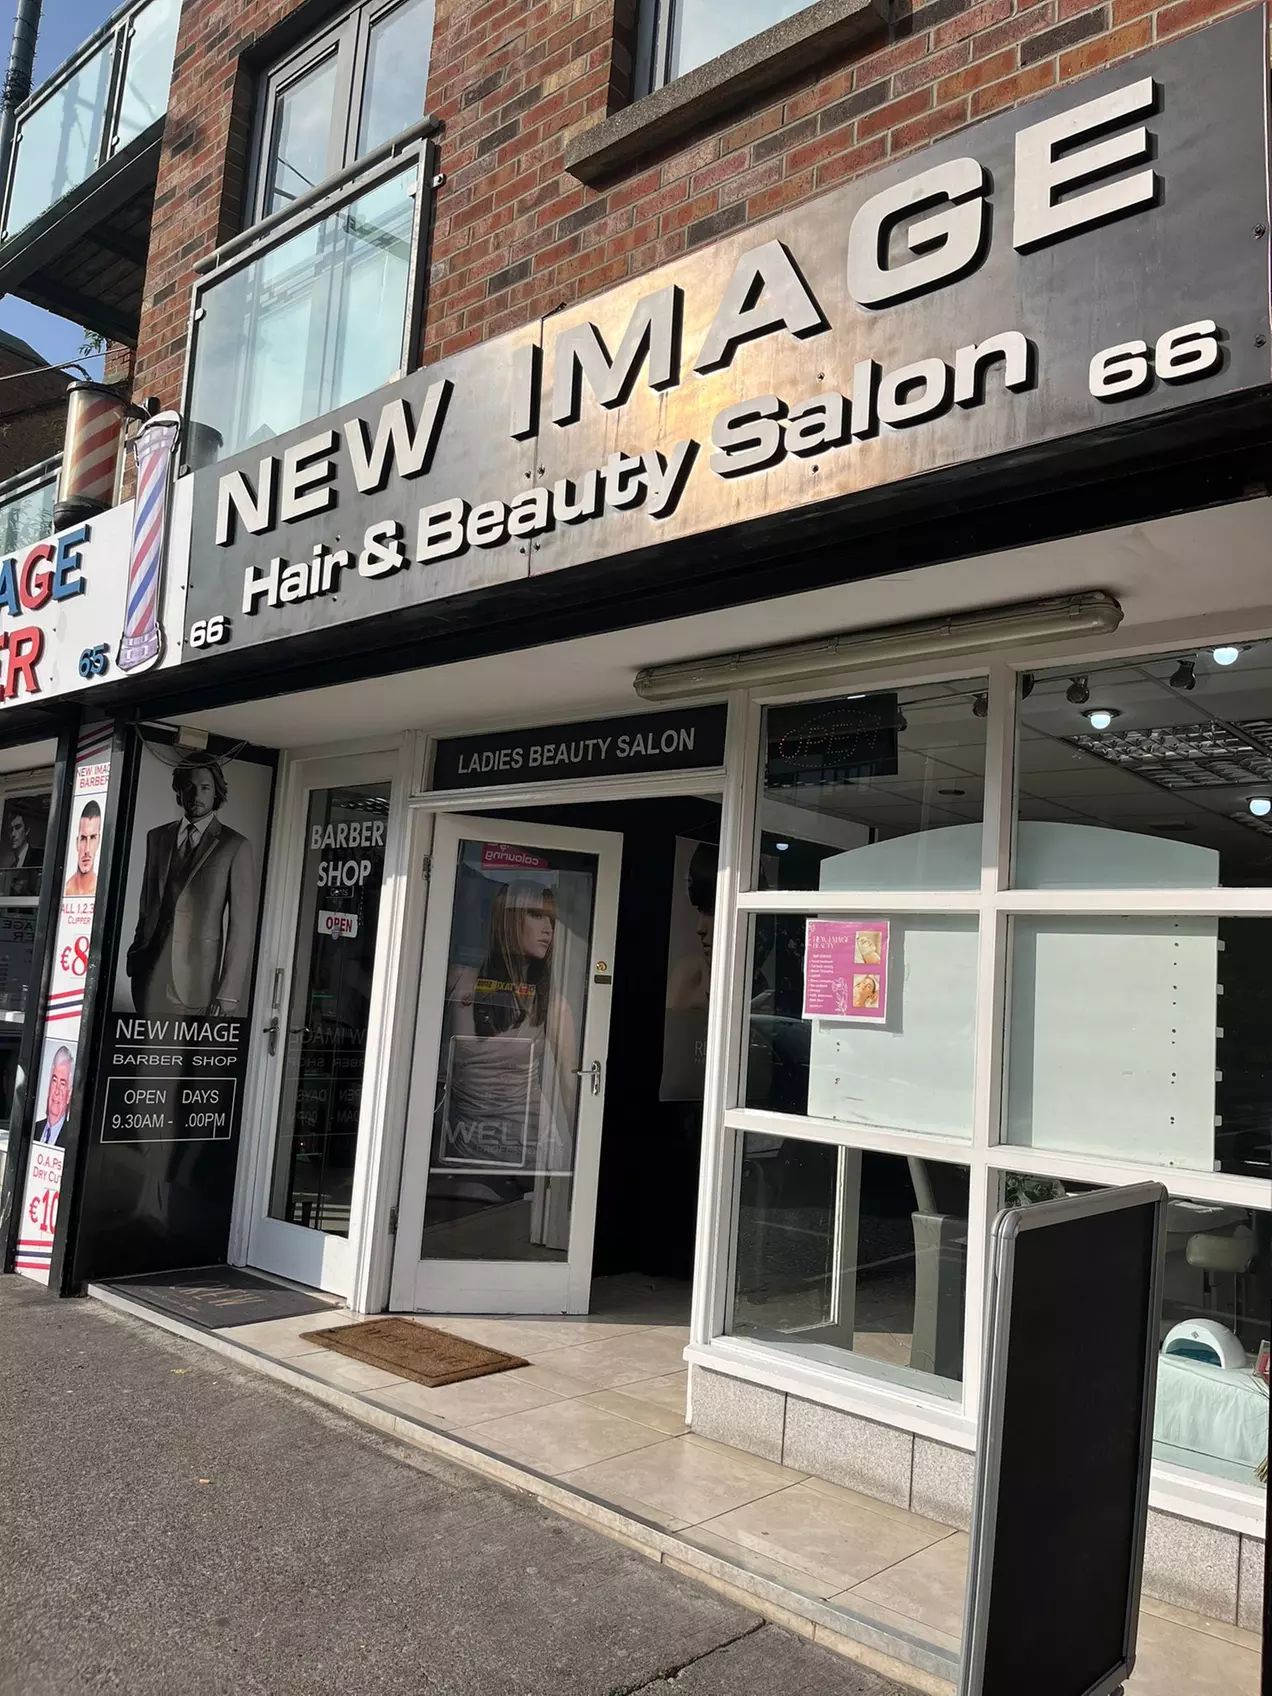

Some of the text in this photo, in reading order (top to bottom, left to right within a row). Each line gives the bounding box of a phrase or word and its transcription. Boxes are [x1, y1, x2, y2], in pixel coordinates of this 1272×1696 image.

[215, 75, 1158, 547] NEW IMAGE
[242, 319, 1222, 614] Hair & Beauty Salon 66
[189, 615, 228, 648] 66
[78, 643, 109, 679] 65
[458, 727, 695, 774] LADIES BEAUTY SALON
[76, 766, 93, 777] NEW
[311, 821, 384, 850] BARBER
[317, 860, 372, 887] SHOP
[68, 916, 91, 924] CLIPPER
[326, 917, 353, 932] OPEN
[60, 936, 90, 976] €8
[115, 1019, 240, 1042] NEW IMAGE
[113, 1054, 237, 1066] BARBER SHOP
[124, 1090, 219, 1104] OPEN DAYS
[112, 1114, 164, 1128] 9.30AM
[185, 1113, 225, 1127] .00PM
[33, 1166, 47, 1180] DRY
